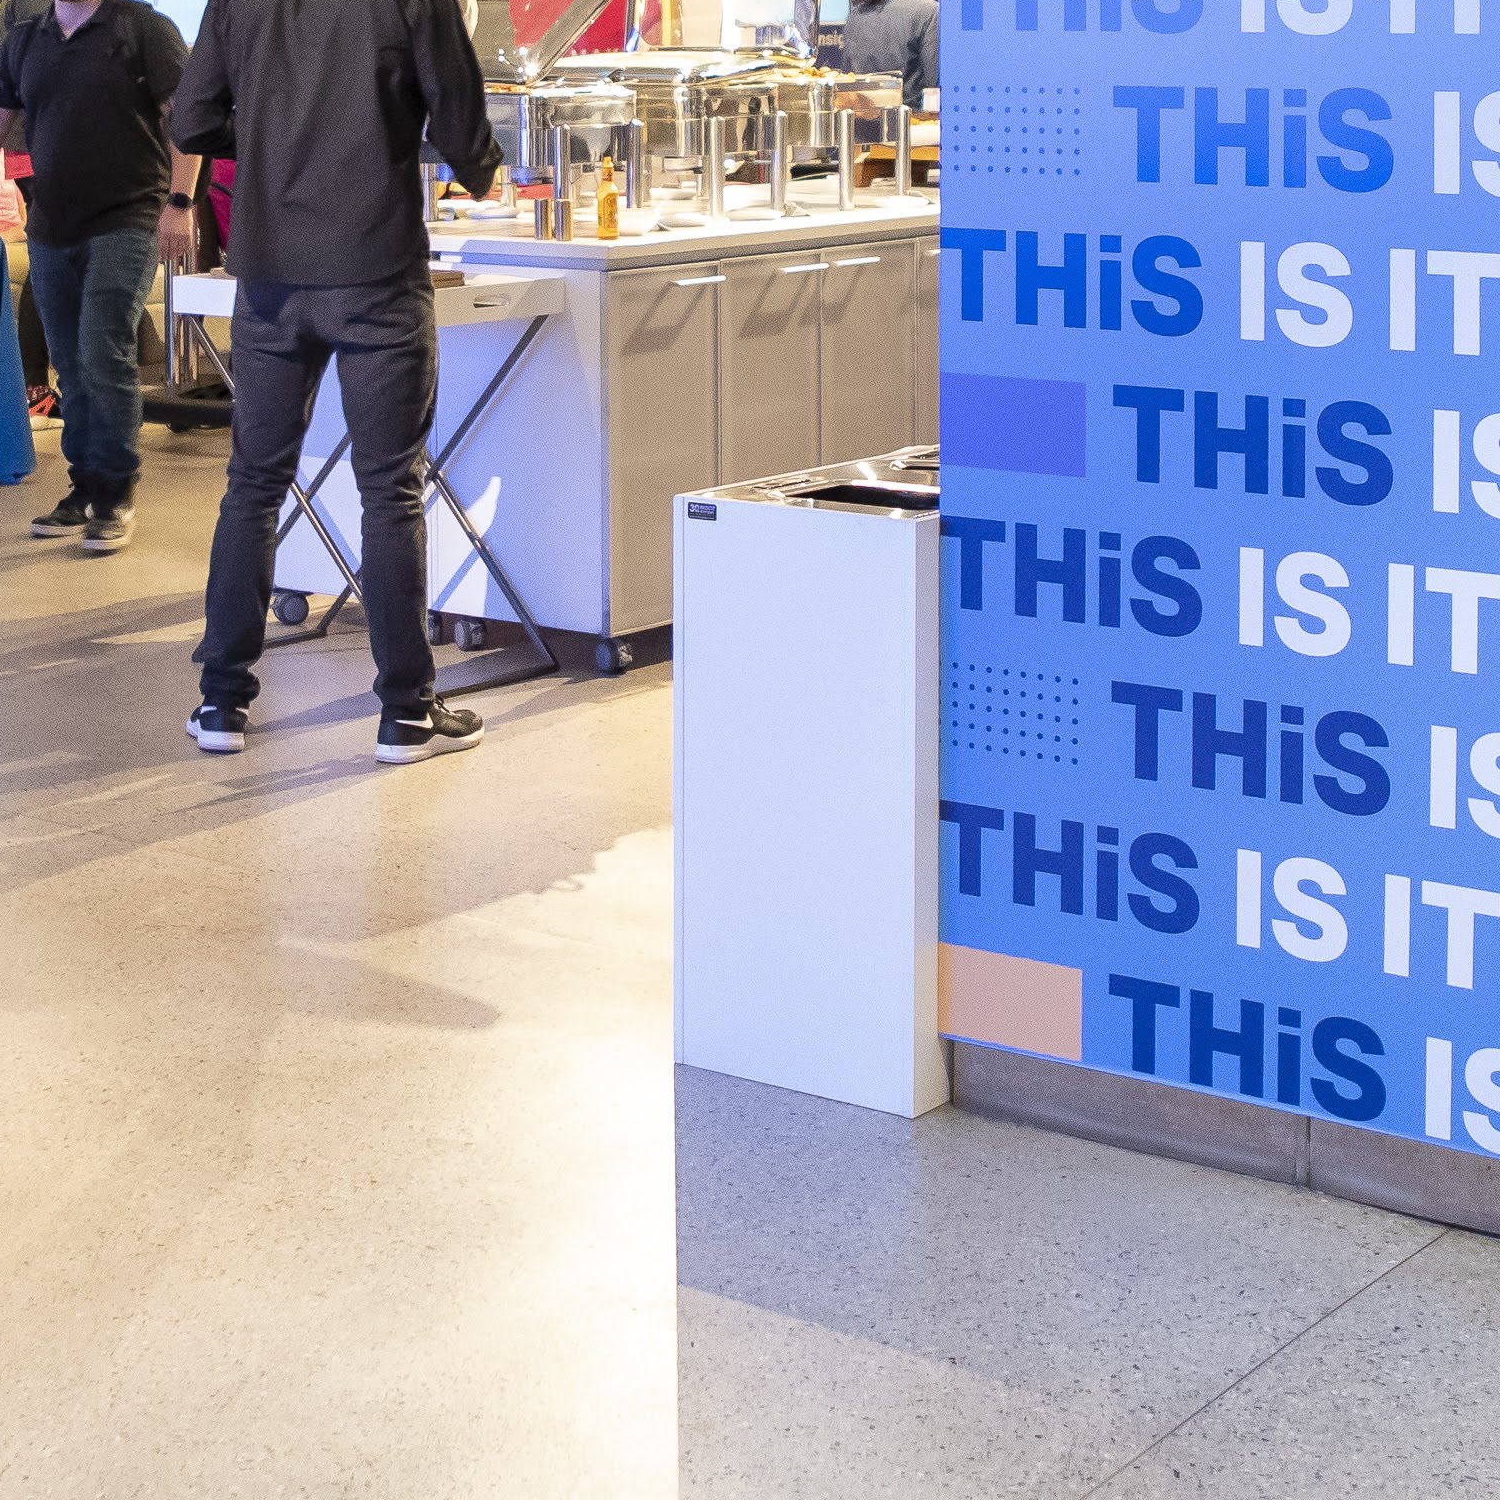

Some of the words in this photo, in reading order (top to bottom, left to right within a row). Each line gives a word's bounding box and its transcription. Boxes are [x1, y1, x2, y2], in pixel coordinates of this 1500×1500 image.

[1113, 85, 1394, 193] THiS
[940, 227, 1203, 337] THiS
[1241, 241, 1353, 348] IS
[1113, 384, 1393, 506] THiS
[940, 515, 1202, 638] THiS
[1239, 547, 1351, 657] IS
[1111, 680, 1391, 816] THiS
[940, 800, 1199, 934] THiS
[1237, 848, 1348, 962] IS
[1383, 875, 1500, 990] IT
[1108, 973, 1386, 1122] THiS
